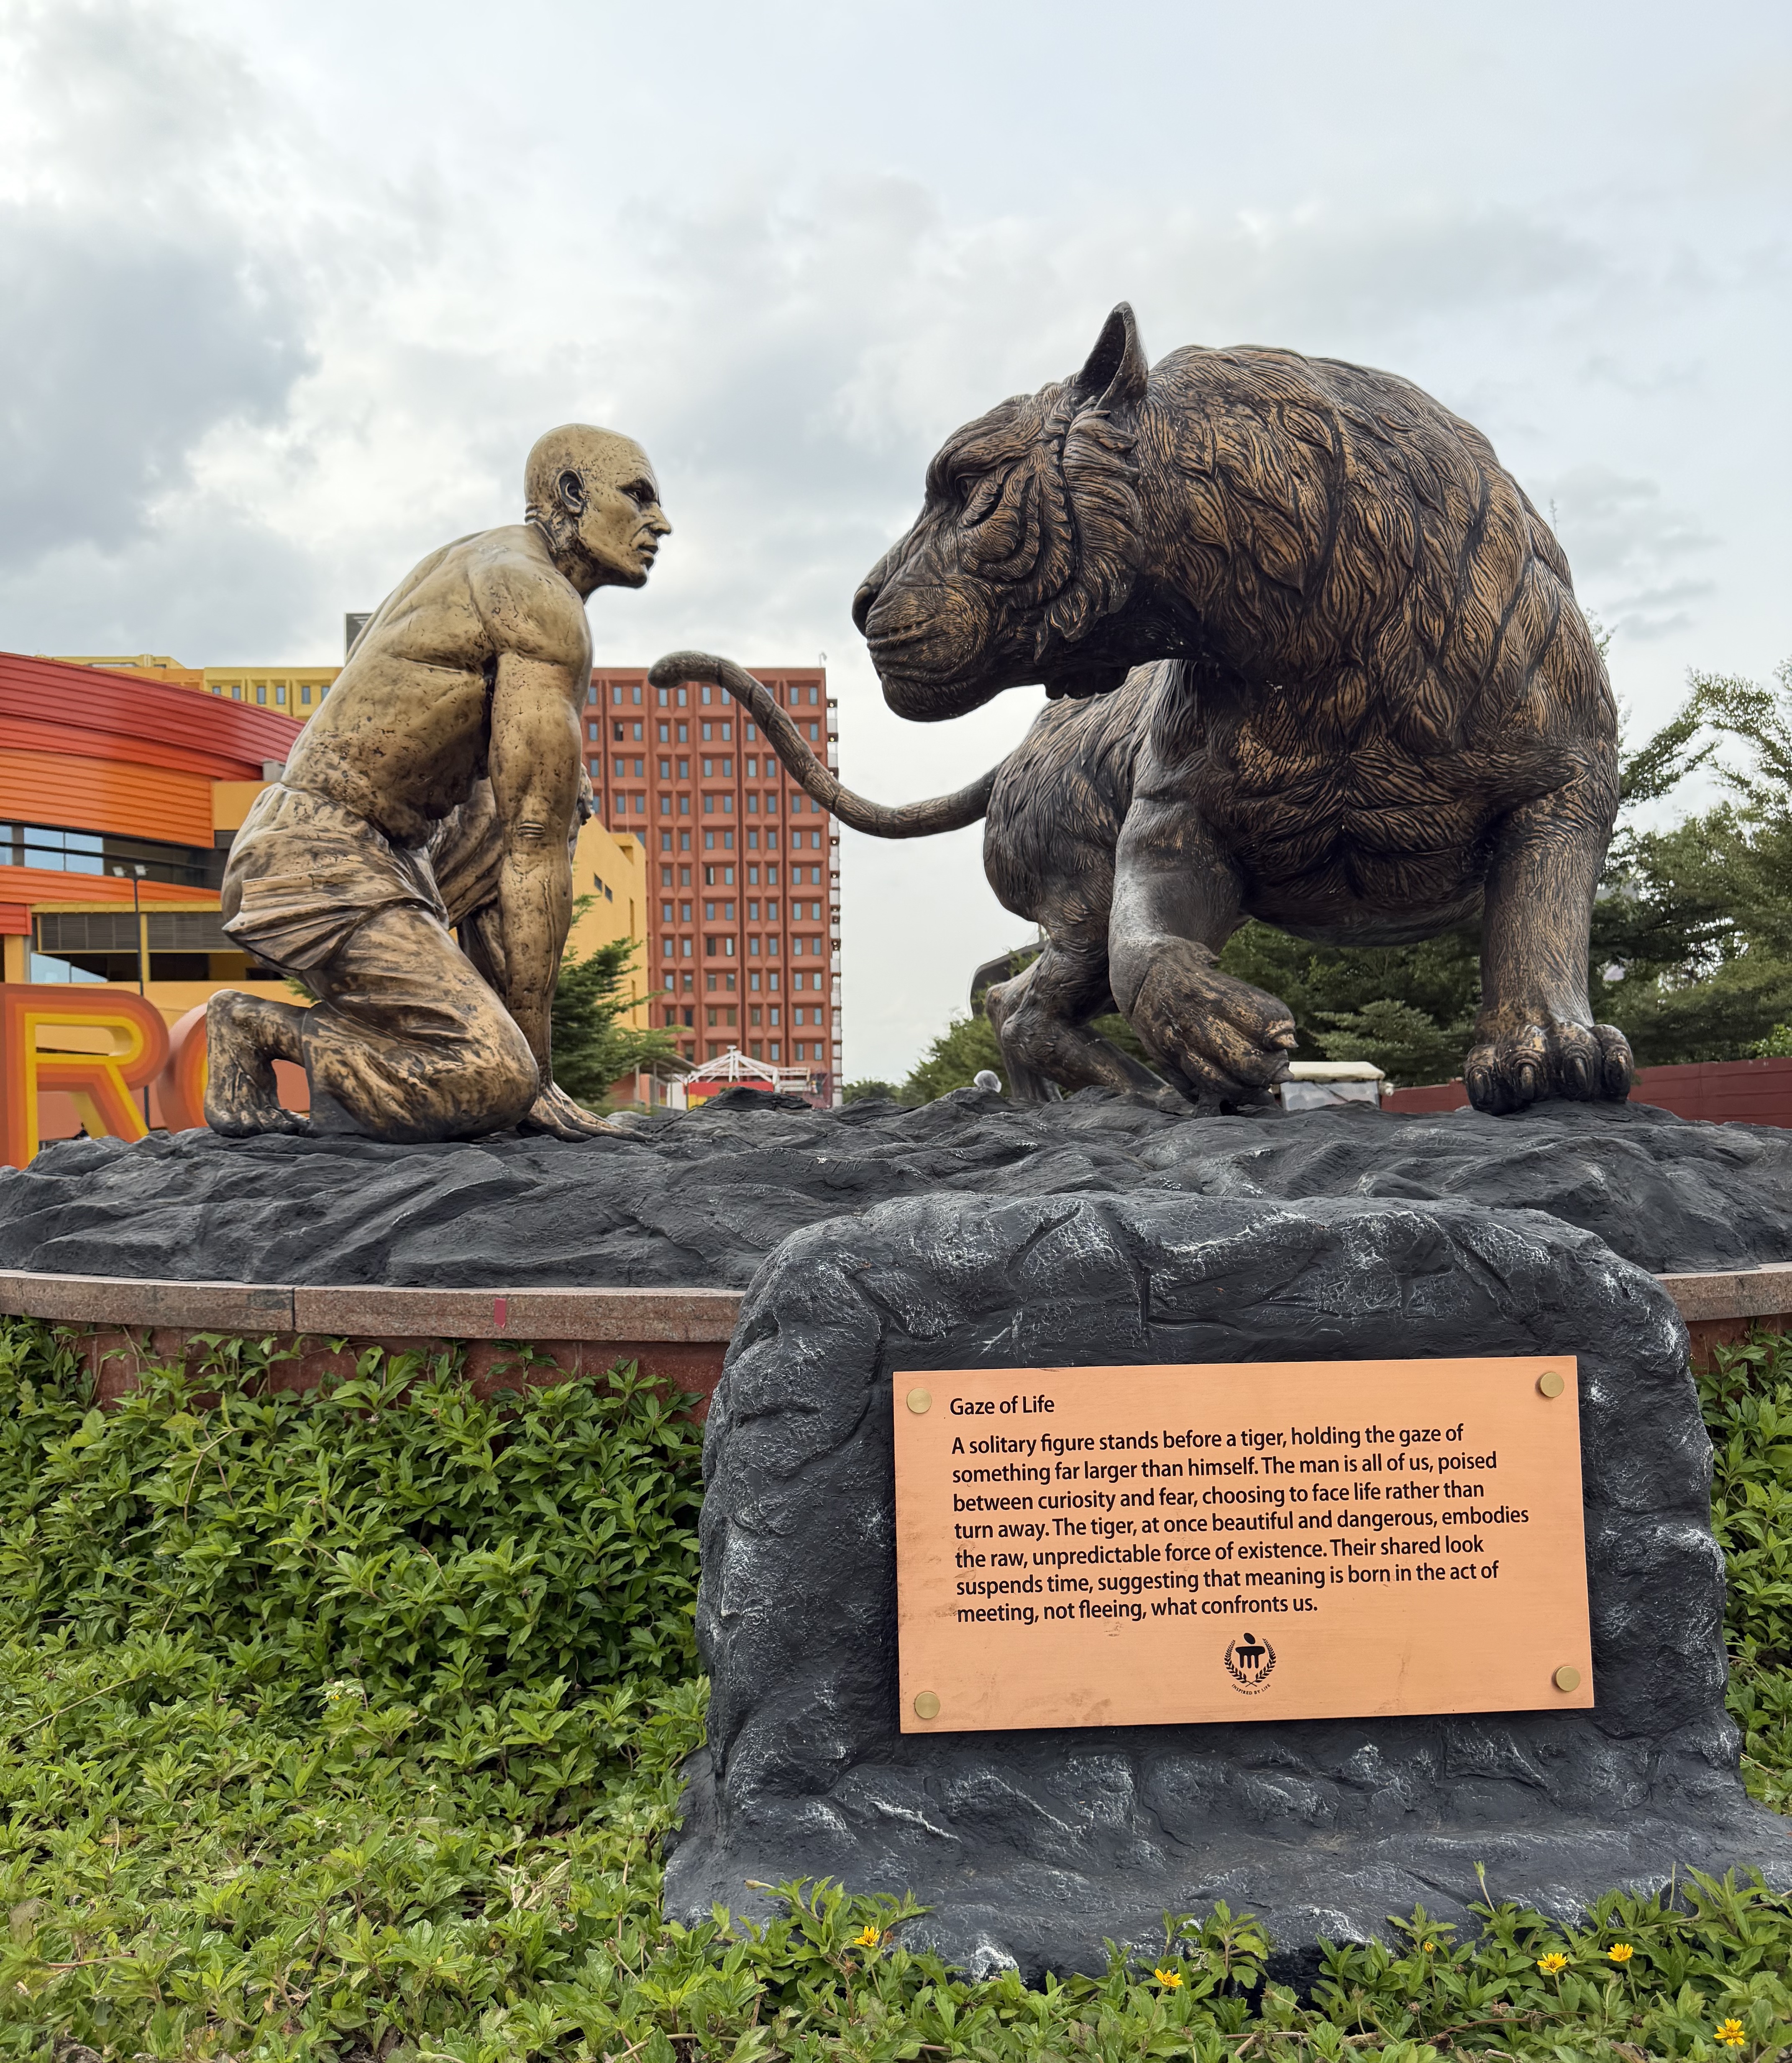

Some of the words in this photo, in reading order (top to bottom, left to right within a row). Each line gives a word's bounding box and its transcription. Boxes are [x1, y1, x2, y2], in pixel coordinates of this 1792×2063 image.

[950, 1398, 995, 1415] Gaze
[999, 1395, 1019, 1414] of
[1023, 1394, 1055, 1413] Life
[952, 1437, 965, 1454] A
[970, 1435, 1037, 1457] solitary
[1040, 1433, 1095, 1456] figure
[1099, 1430, 1159, 1450] stands
[1163, 1429, 1222, 1448] before
[1226, 1434, 1236, 1447] a
[1240, 1429, 1287, 1451] tiger,
[1291, 1426, 1361, 1448] holding
[1364, 1425, 1395, 1443] the
[1399, 1429, 1441, 1447] gaze
[1446, 1423, 1464, 1441] of
[952, 1463, 1050, 1485] something
[1055, 1461, 1080, 1480] far
[1084, 1461, 1137, 1483] larger
[1141, 1459, 1183, 1477] than
[1188, 1456, 1259, 1476] himself.
[1261, 1456, 1295, 1474] The
[1300, 1459, 1339, 1473] man
[1344, 1455, 1357, 1472] is
[1362, 1453, 1382, 1472] all
[1387, 1452, 1405, 1471] of
[1409, 1457, 1434, 1473] us,
[1438, 1451, 1497, 1474] poised
[953, 1493, 1033, 1512] between
[1038, 1490, 1116, 1512] curiosity
[1120, 1487, 1155, 1507] and
[1159, 1487, 1198, 1507] fear,
[1202, 1485, 1285, 1507] choosing
[1289, 1486, 1308, 1502] to
[1312, 1483, 1349, 1502] face
[1354, 1482, 1381, 1500] life
[1385, 1481, 1440, 1499] rather
[1443, 1480, 1484, 1498] than
[954, 1523, 993, 1539] turn
[998, 1523, 1050, 1542] away.
[1052, 1517, 1086, 1536] The
[1090, 1517, 1137, 1539] tiger,
[1142, 1517, 1160, 1533] at
[1164, 1518, 1208, 1533] once
[1212, 1511, 1293, 1531] beautiful
[1298, 1510, 1332, 1529] and
[1337, 1509, 1437, 1532] dangerous,
[1442, 1505, 1529, 1525] embodies
[955, 1549, 986, 1568] the
[991, 1553, 1028, 1569] raw,
[1033, 1543, 1161, 1569] unpredictable
[1165, 1543, 1211, 1561] force
[1215, 1541, 1234, 1560] of
[1238, 1541, 1327, 1559] existence.
[1329, 1538, 1376, 1556] Their
[1381, 1535, 1441, 1555] shared
[1445, 1534, 1485, 1553] look
[957, 1574, 1043, 1599] suspends
[1047, 1574, 1093, 1594] time,
[1098, 1570, 1198, 1595] suggesting
[1203, 1568, 1241, 1587] that
[1245, 1567, 1325, 1589] meaning
[1330, 1566, 1344, 1583] is
[1348, 1564, 1390, 1583] born
[1395, 1564, 1411, 1581] in
[1416, 1562, 1446, 1581] the
[1450, 1563, 1477, 1580] act
[1481, 1560, 1499, 1579] of
[957, 1603, 1039, 1625] meeting,
[1044, 1603, 1075, 1620] not
[1078, 1599, 1147, 1622] fleeing,
[1151, 1597, 1197, 1616] what
[1201, 1594, 1288, 1614] confronts
[1293, 1598, 1318, 1612] us.
[1231, 1684, 1252, 1695] INSPIRED
[1261, 1683, 1271, 1692] LIFE
